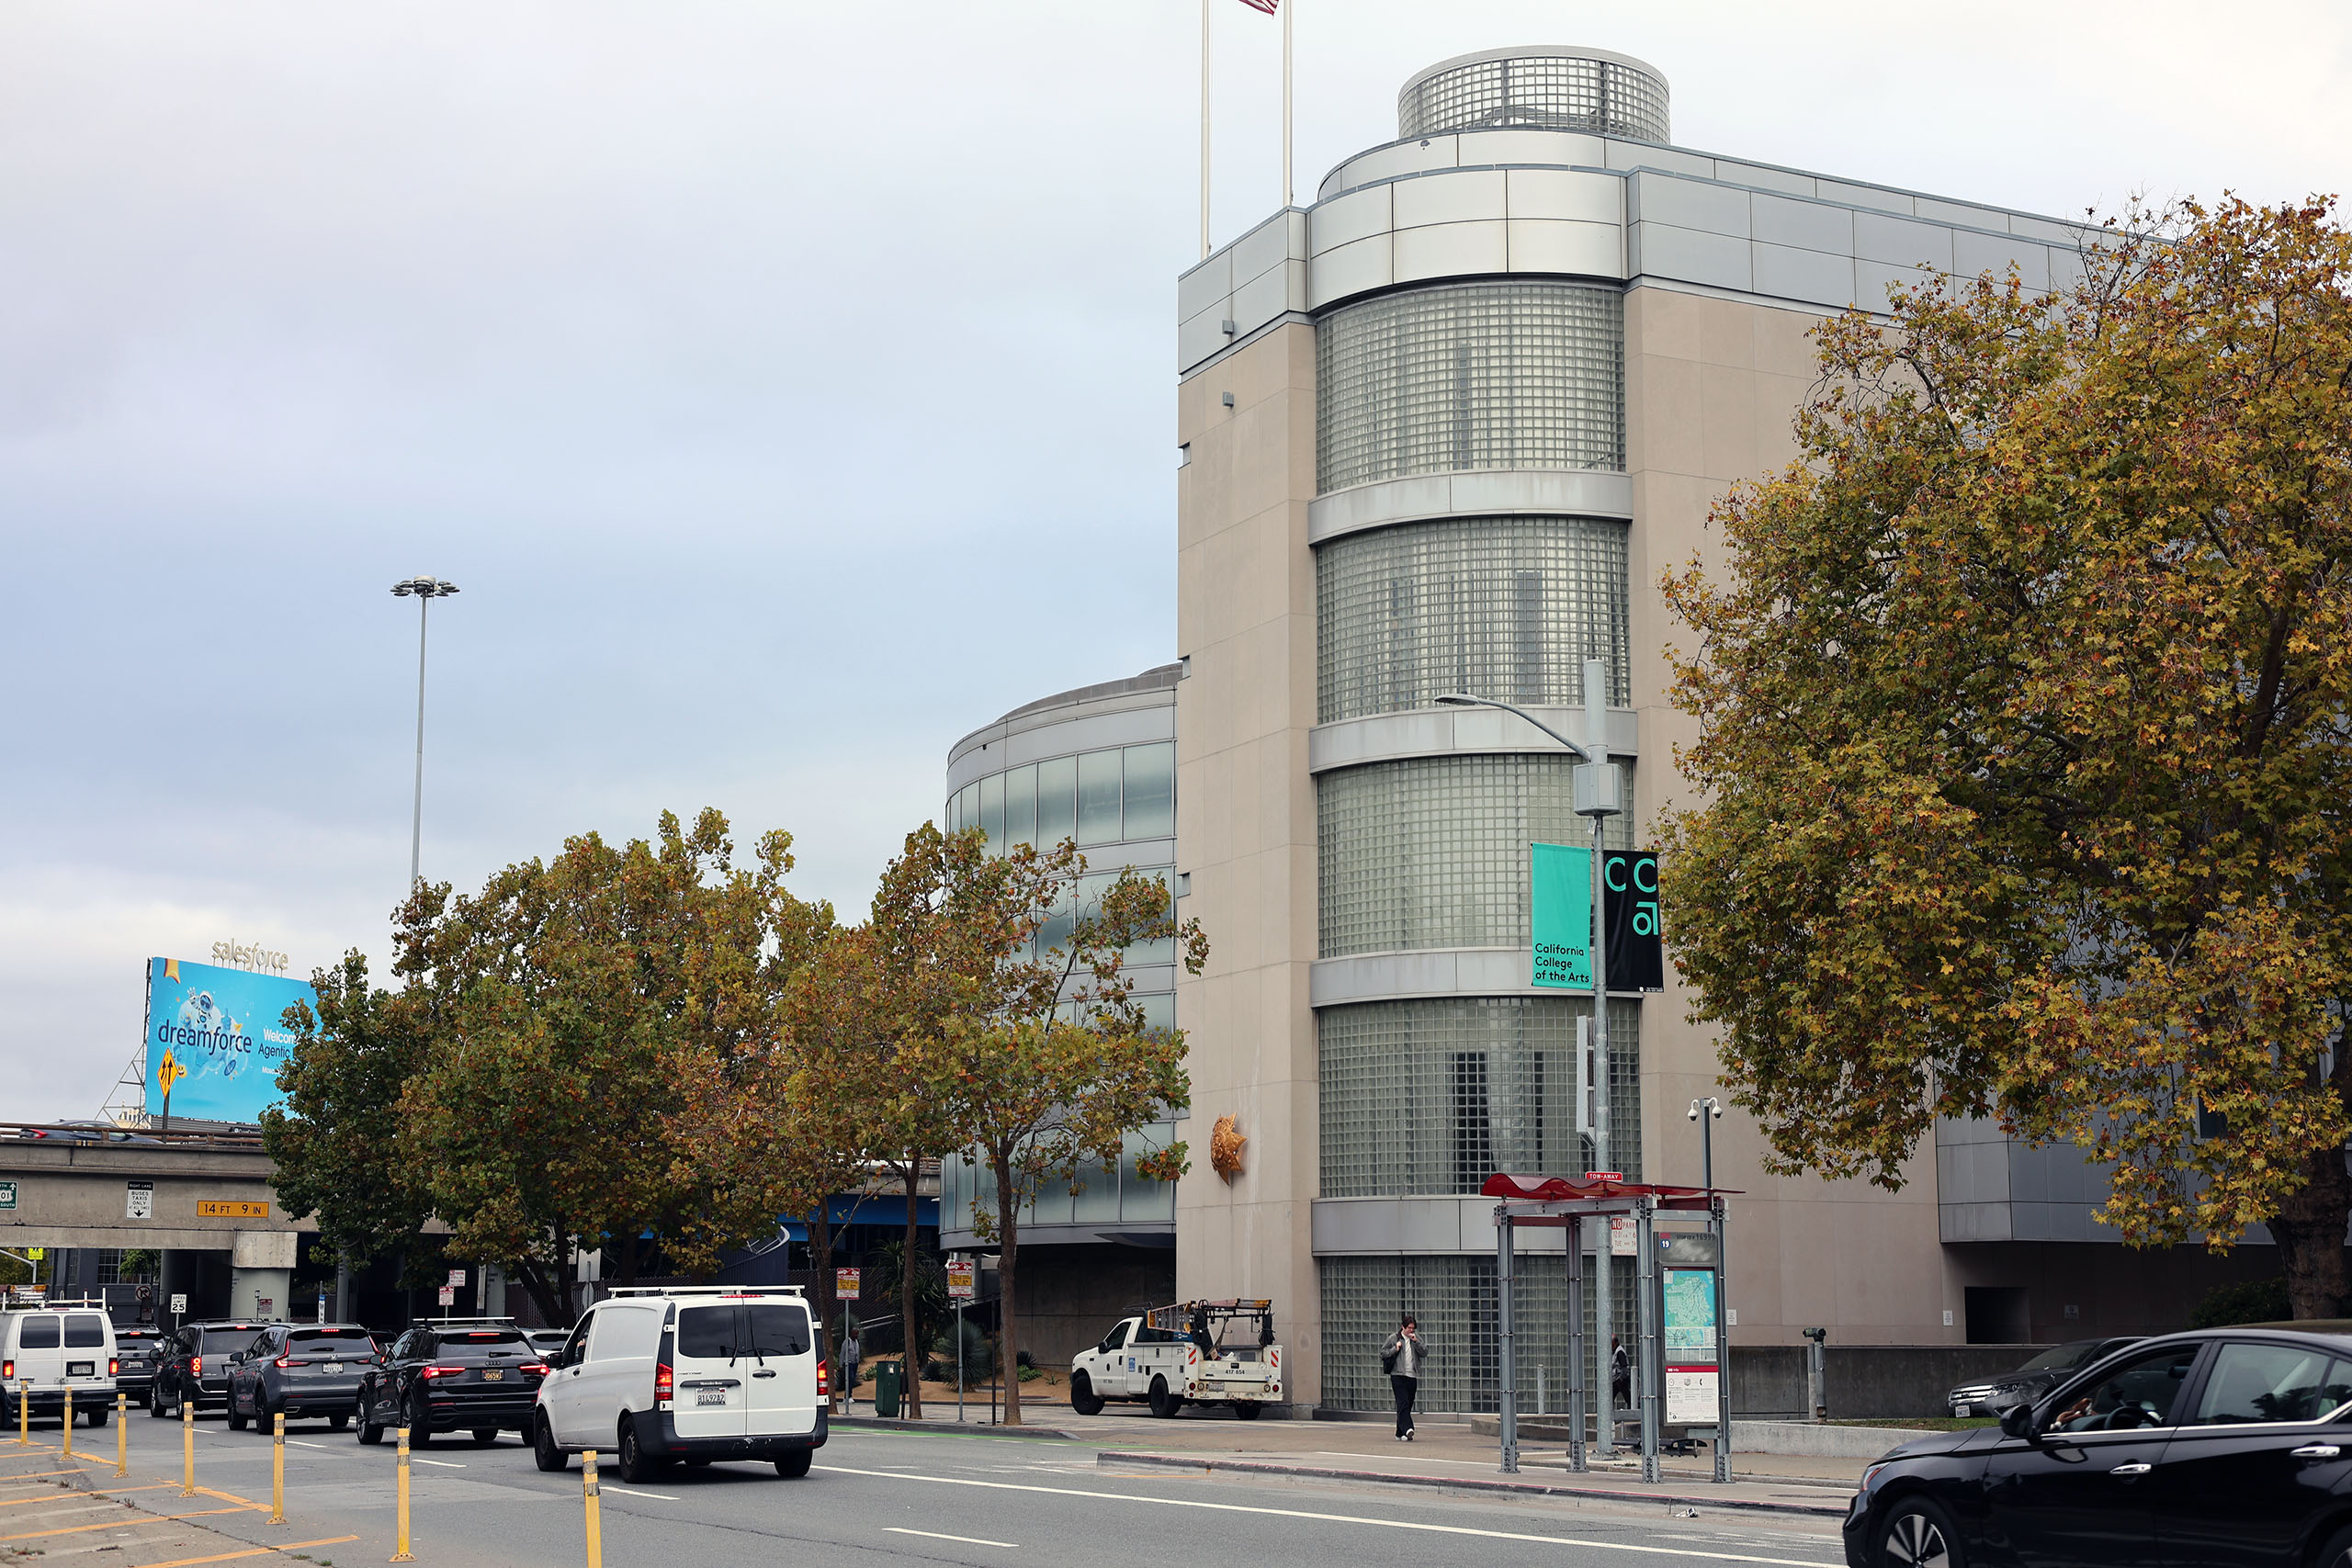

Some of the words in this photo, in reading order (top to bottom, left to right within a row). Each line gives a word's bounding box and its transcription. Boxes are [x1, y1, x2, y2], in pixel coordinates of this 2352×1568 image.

[212, 938, 289, 971] salesforce
[1535, 942, 1585, 956] California
[1535, 956, 1573, 971] College
[1535, 970, 1546, 980] of
[1549, 971, 1566, 981] the
[1567, 972, 1590, 983] Arts
[158, 1020, 253, 1055] dreamforce
[263, 1028, 298, 1044] Welcom
[258, 1043, 290, 1059] Agentic
[0, 1191, 9, 1200] 01
[205, 1203, 216, 1213] 14
[220, 1205, 231, 1214] FT
[242, 1204, 249, 1214] 9
[253, 1206, 261, 1214] IN
[1611, 1219, 1622, 1229] NO
[1662, 1240, 1670, 1248] 19
